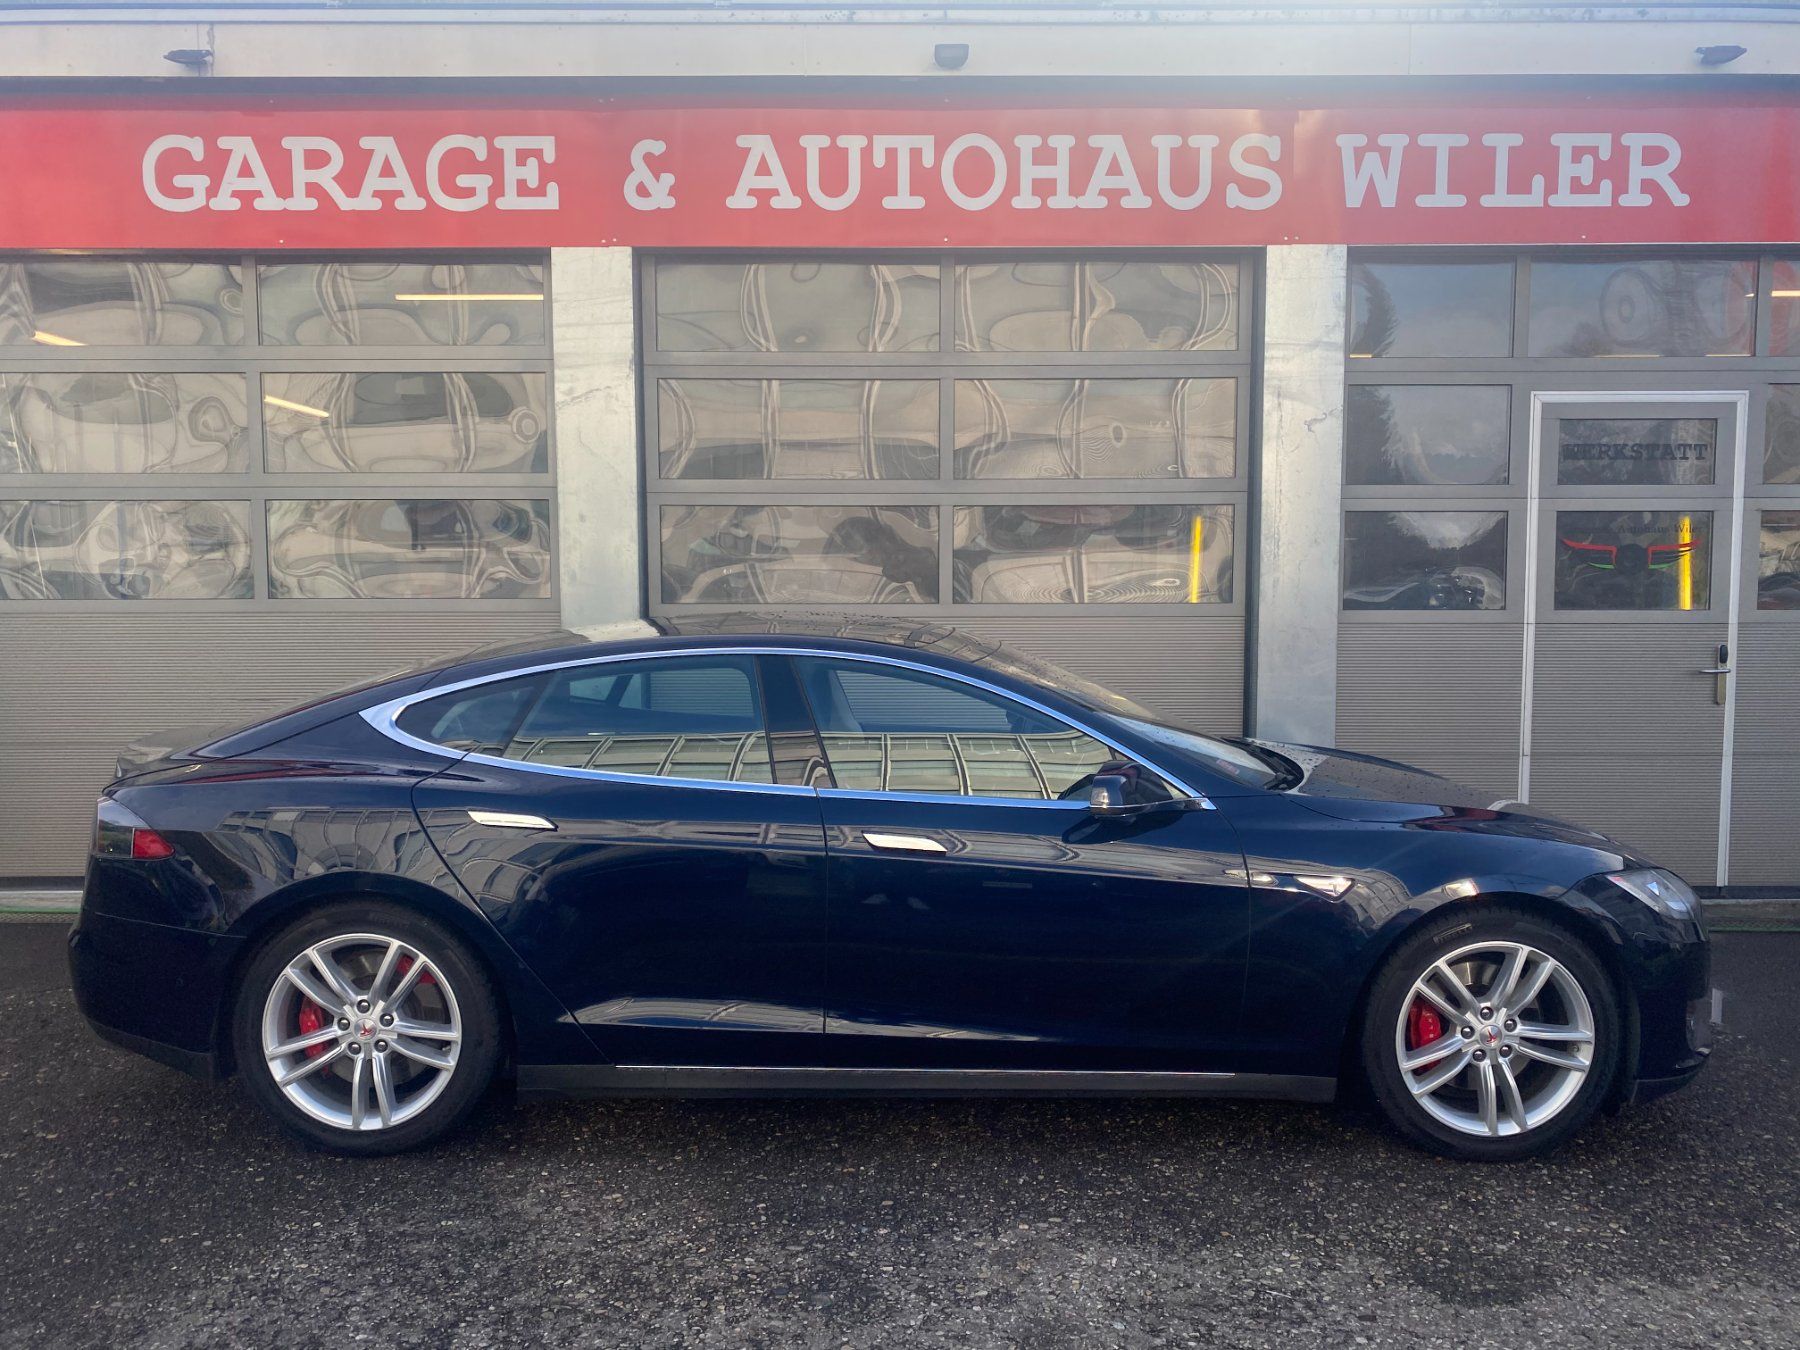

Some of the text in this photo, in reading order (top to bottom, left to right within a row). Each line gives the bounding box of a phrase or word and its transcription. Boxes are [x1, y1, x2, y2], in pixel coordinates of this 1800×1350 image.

[142, 132, 1691, 212] GARAGE & AUTOHAUS WILER
